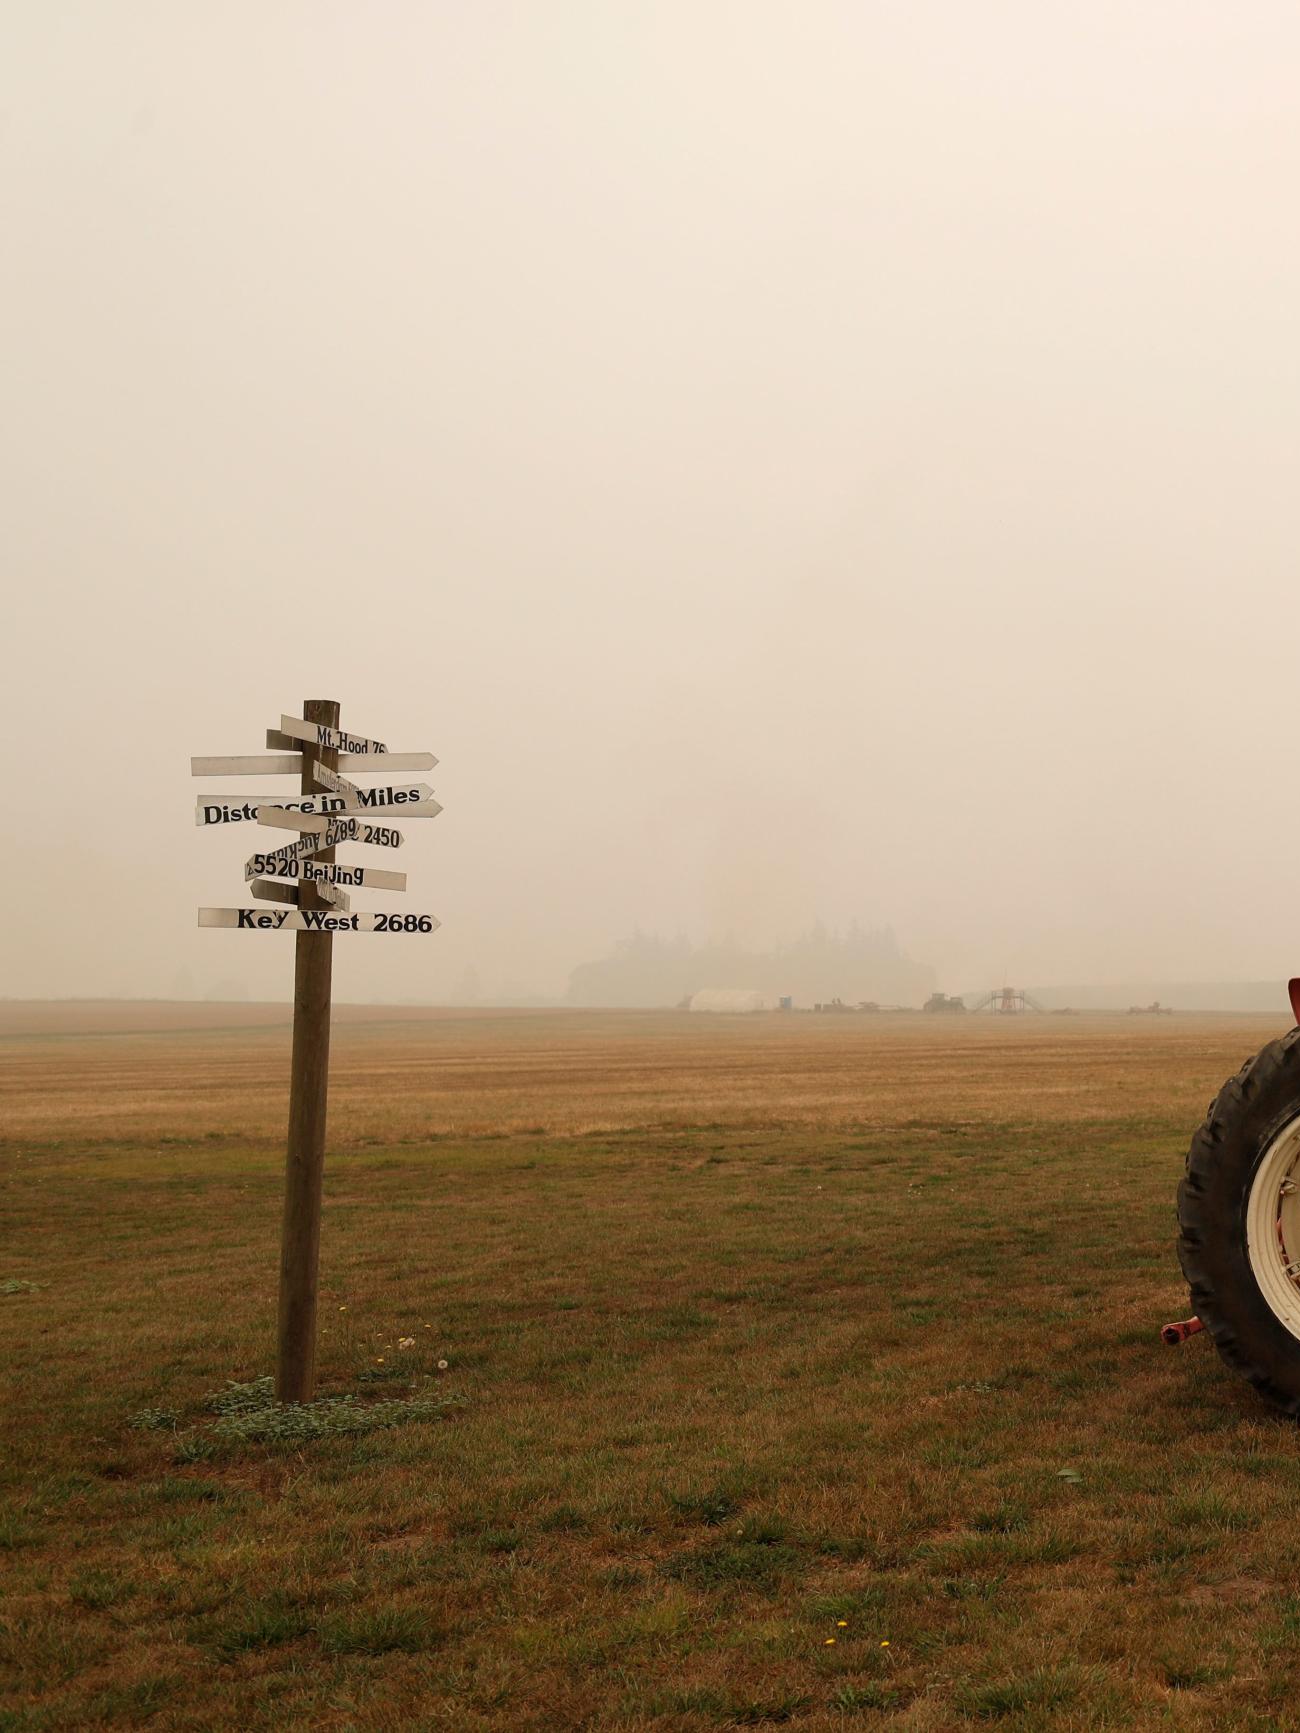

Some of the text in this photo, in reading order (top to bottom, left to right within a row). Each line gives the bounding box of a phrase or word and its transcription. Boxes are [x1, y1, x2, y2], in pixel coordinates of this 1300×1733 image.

[317, 725, 335, 747] Mt.
[336, 731, 368, 754] Hood
[321, 795, 346, 811] in
[355, 787, 420, 807] Miles
[364, 825, 400, 848] 2450
[254, 854, 299, 878] 5520
[237, 909, 433, 933] Key West 2686
